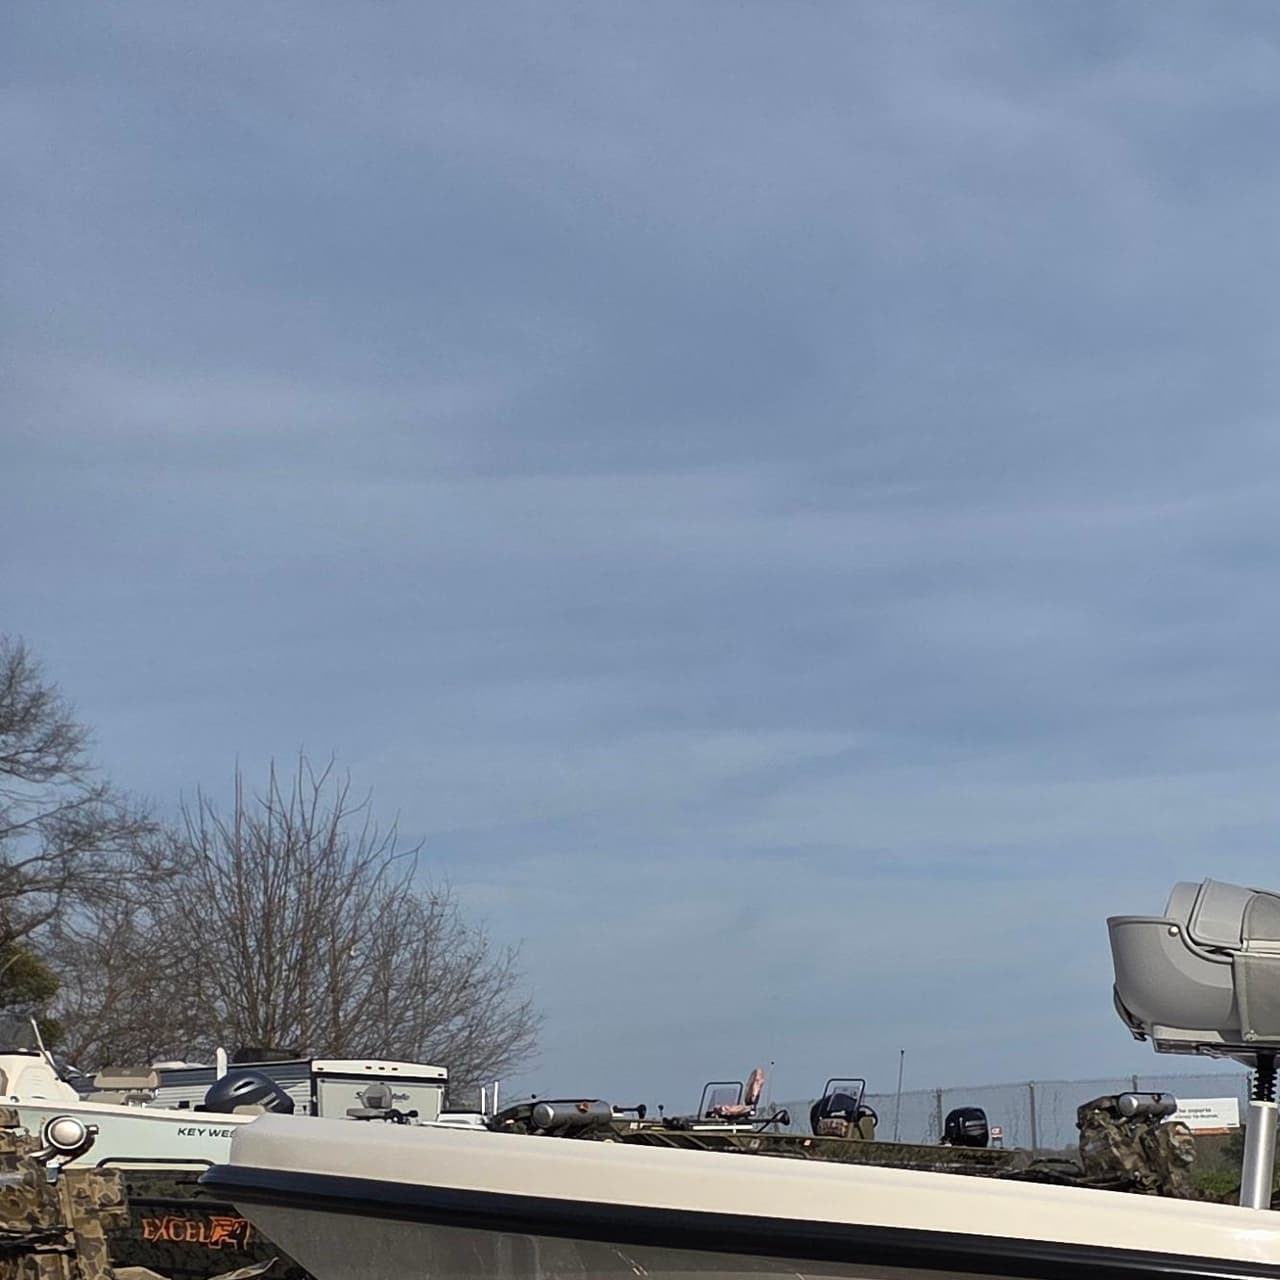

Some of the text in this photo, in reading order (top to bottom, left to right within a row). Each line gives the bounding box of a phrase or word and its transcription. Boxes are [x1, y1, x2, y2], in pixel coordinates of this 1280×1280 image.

[178, 1128, 233, 1138] KEY WE
[142, 1216, 209, 1242] EXCEL
